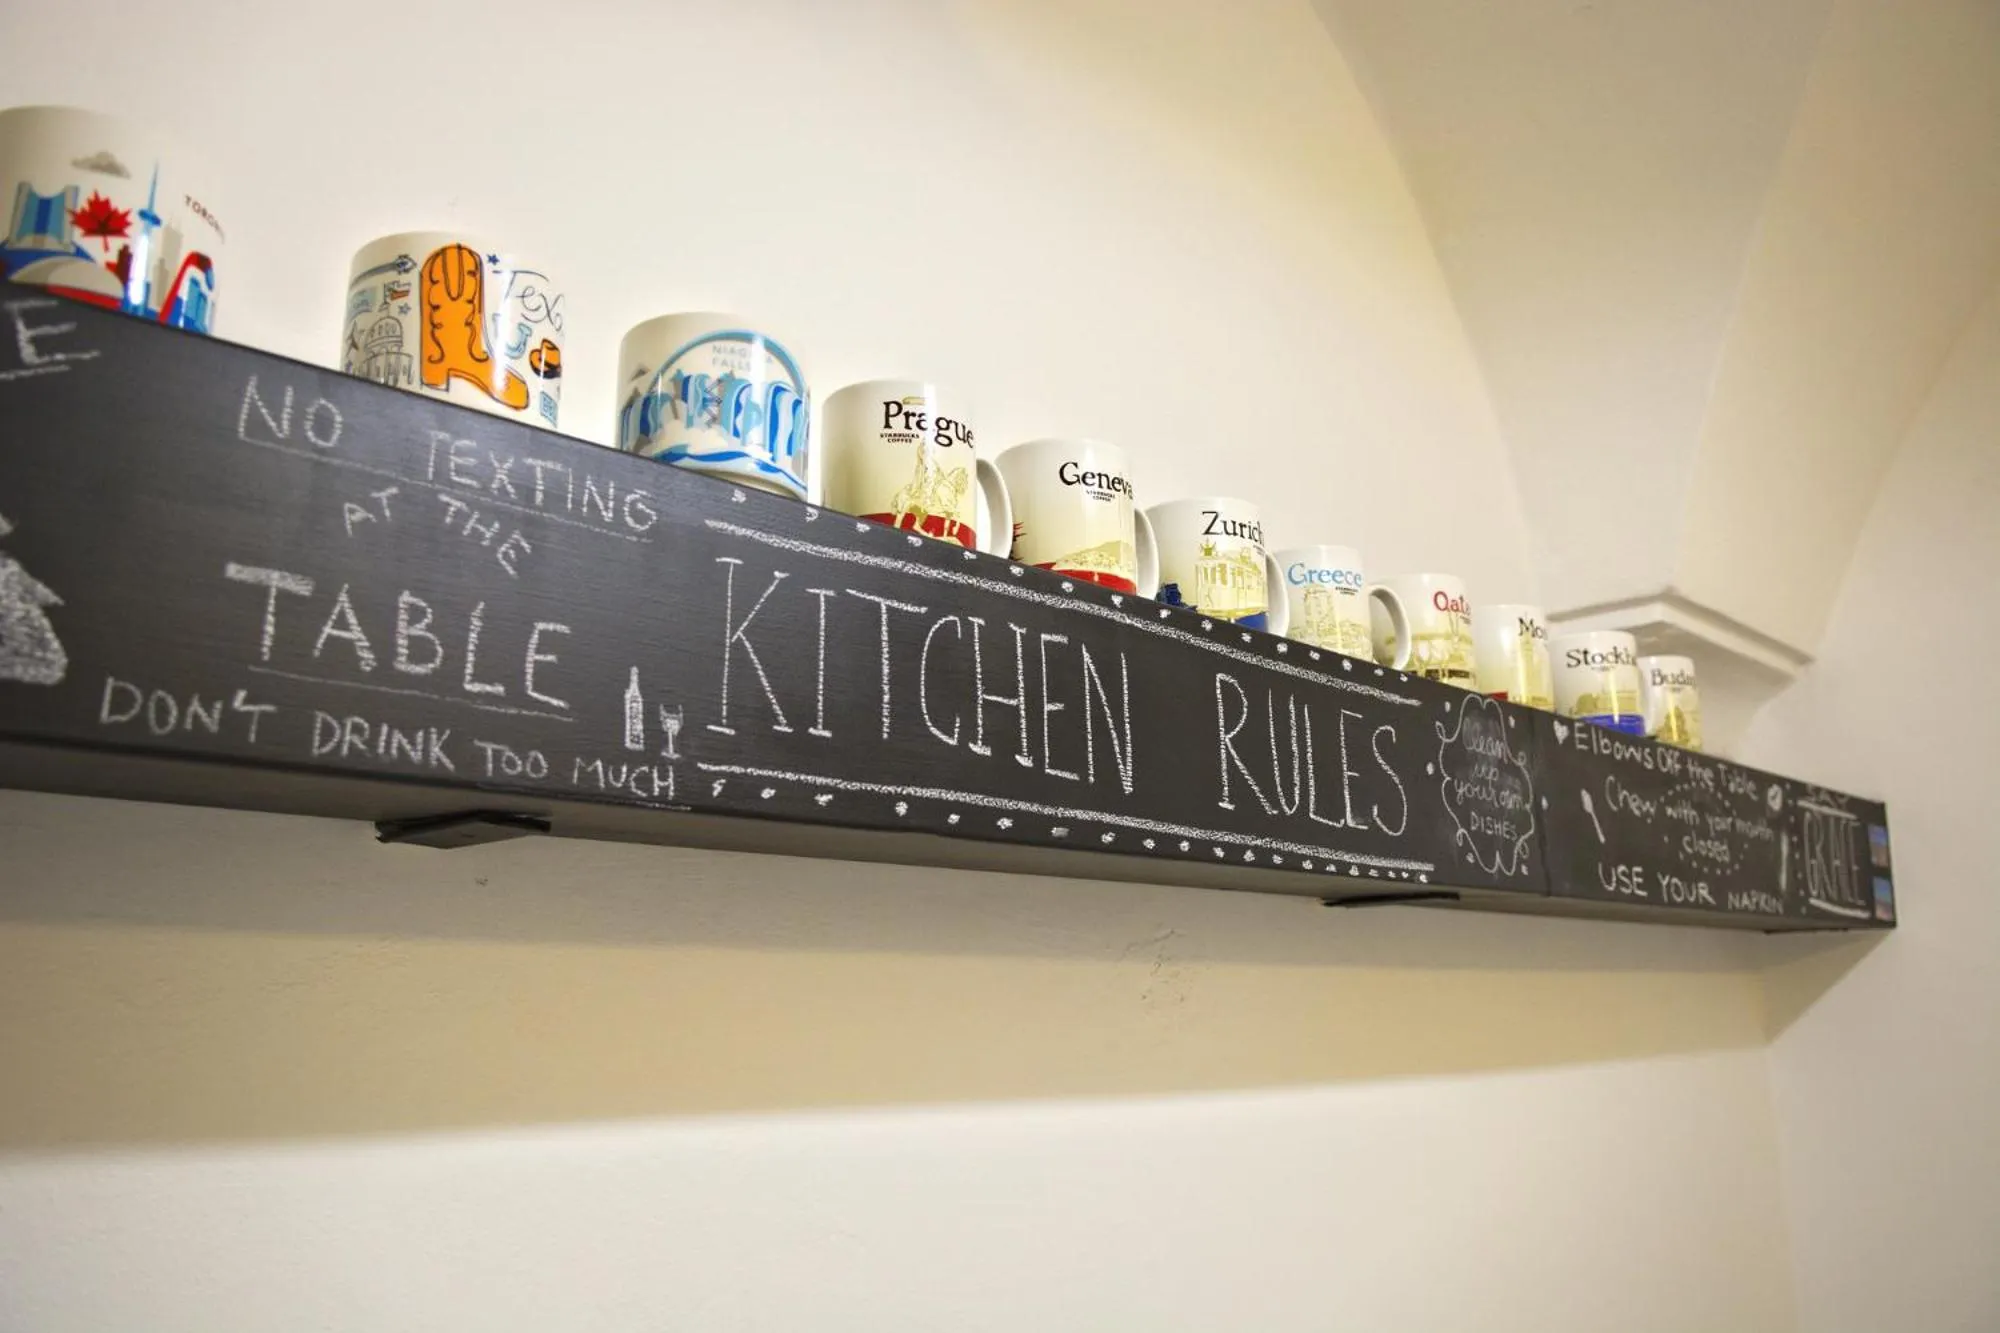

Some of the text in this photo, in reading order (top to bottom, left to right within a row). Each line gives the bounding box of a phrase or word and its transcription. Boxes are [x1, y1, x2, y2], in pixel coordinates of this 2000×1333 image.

[882, 400, 975, 449] Prague
[237, 374, 658, 533] NO TEXTING
[342, 486, 532, 579] AT THE
[1287, 562, 1363, 588] Greece
[224, 562, 573, 709] TABLE
[707, 557, 1408, 837] KITCHEN RULES
[100, 677, 675, 801] DON'T DRINK TOO MUCH
[1574, 722, 1655, 769] Elbows
[1605, 775, 1658, 818] Chew
[1470, 811, 1518, 842] DISHES
[1598, 862, 1785, 915] USE YOUR NAPKIN
